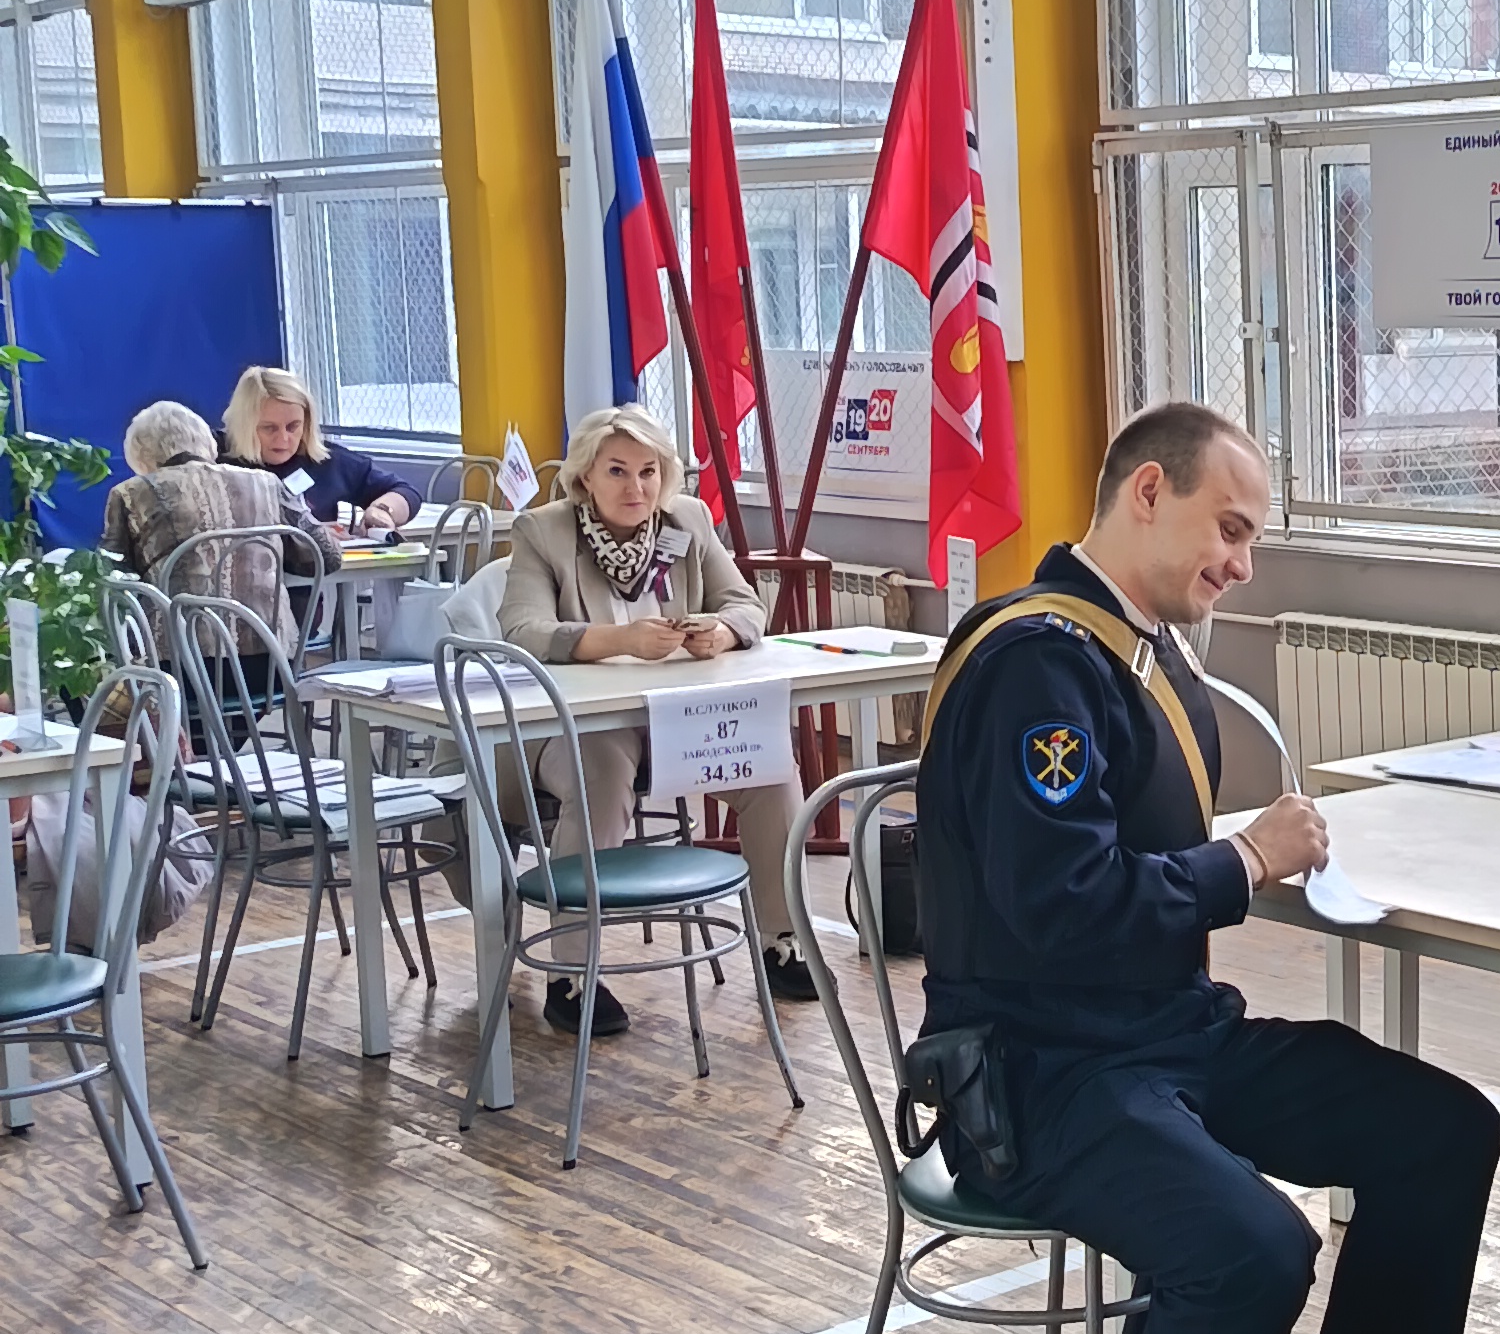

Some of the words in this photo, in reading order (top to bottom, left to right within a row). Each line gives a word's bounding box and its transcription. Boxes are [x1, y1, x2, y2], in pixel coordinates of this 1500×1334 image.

[1447, 288, 1482, 307] ТВОЙ
[869, 398, 891, 422] 20
[848, 408, 866, 432] 19
[684, 698, 758, 717] В.СЛУЦКОЙ
[717, 720, 739, 739] 87
[682, 742, 748, 761] ЗАВОДСКОЙ
[700, 761, 753, 784] 34,36
